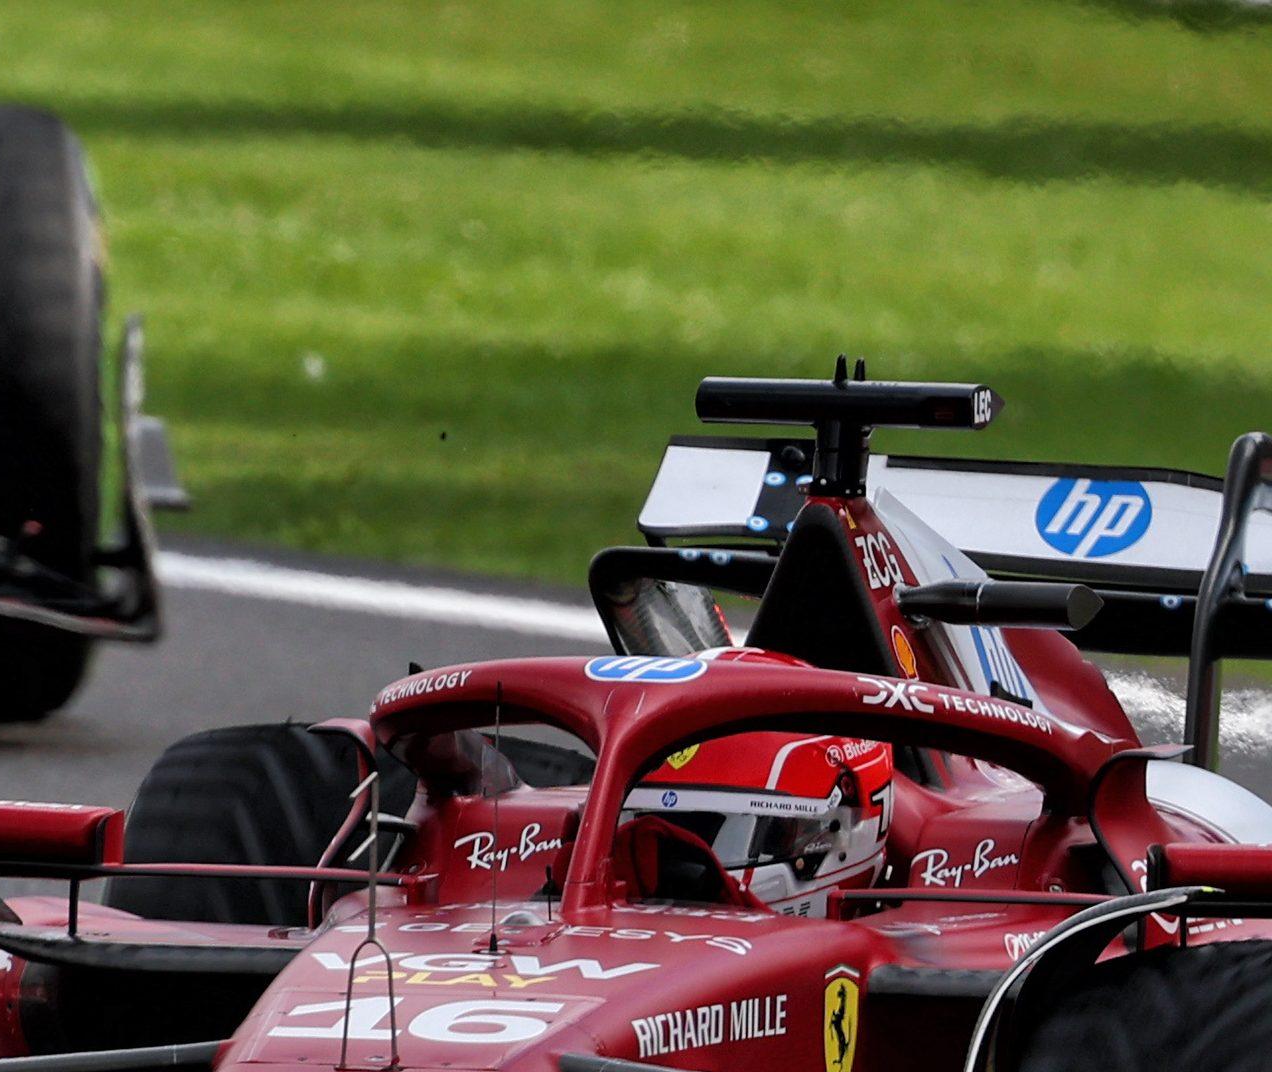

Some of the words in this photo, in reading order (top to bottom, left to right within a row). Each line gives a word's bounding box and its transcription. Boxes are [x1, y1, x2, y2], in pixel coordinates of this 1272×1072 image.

[973, 390, 992, 423] LEC
[1047, 478, 1144, 558] hp
[379, 669, 473, 707] TECHNOLOGY
[937, 693, 1053, 735] TECHNOLOGY
[749, 799, 793, 811] RICHARD
[793, 803, 819, 814] MILLE
[454, 822, 563, 872] Ray-Ban
[911, 838, 1019, 888] Ray-Ban
[398, 922, 753, 956] GEESYS
[312, 951, 661, 979] VGW
[352, 970, 559, 988] PLAY
[266, 996, 568, 1043] 16
[631, 1003, 724, 1059] RICHARD
[729, 994, 788, 1041] MILLE
